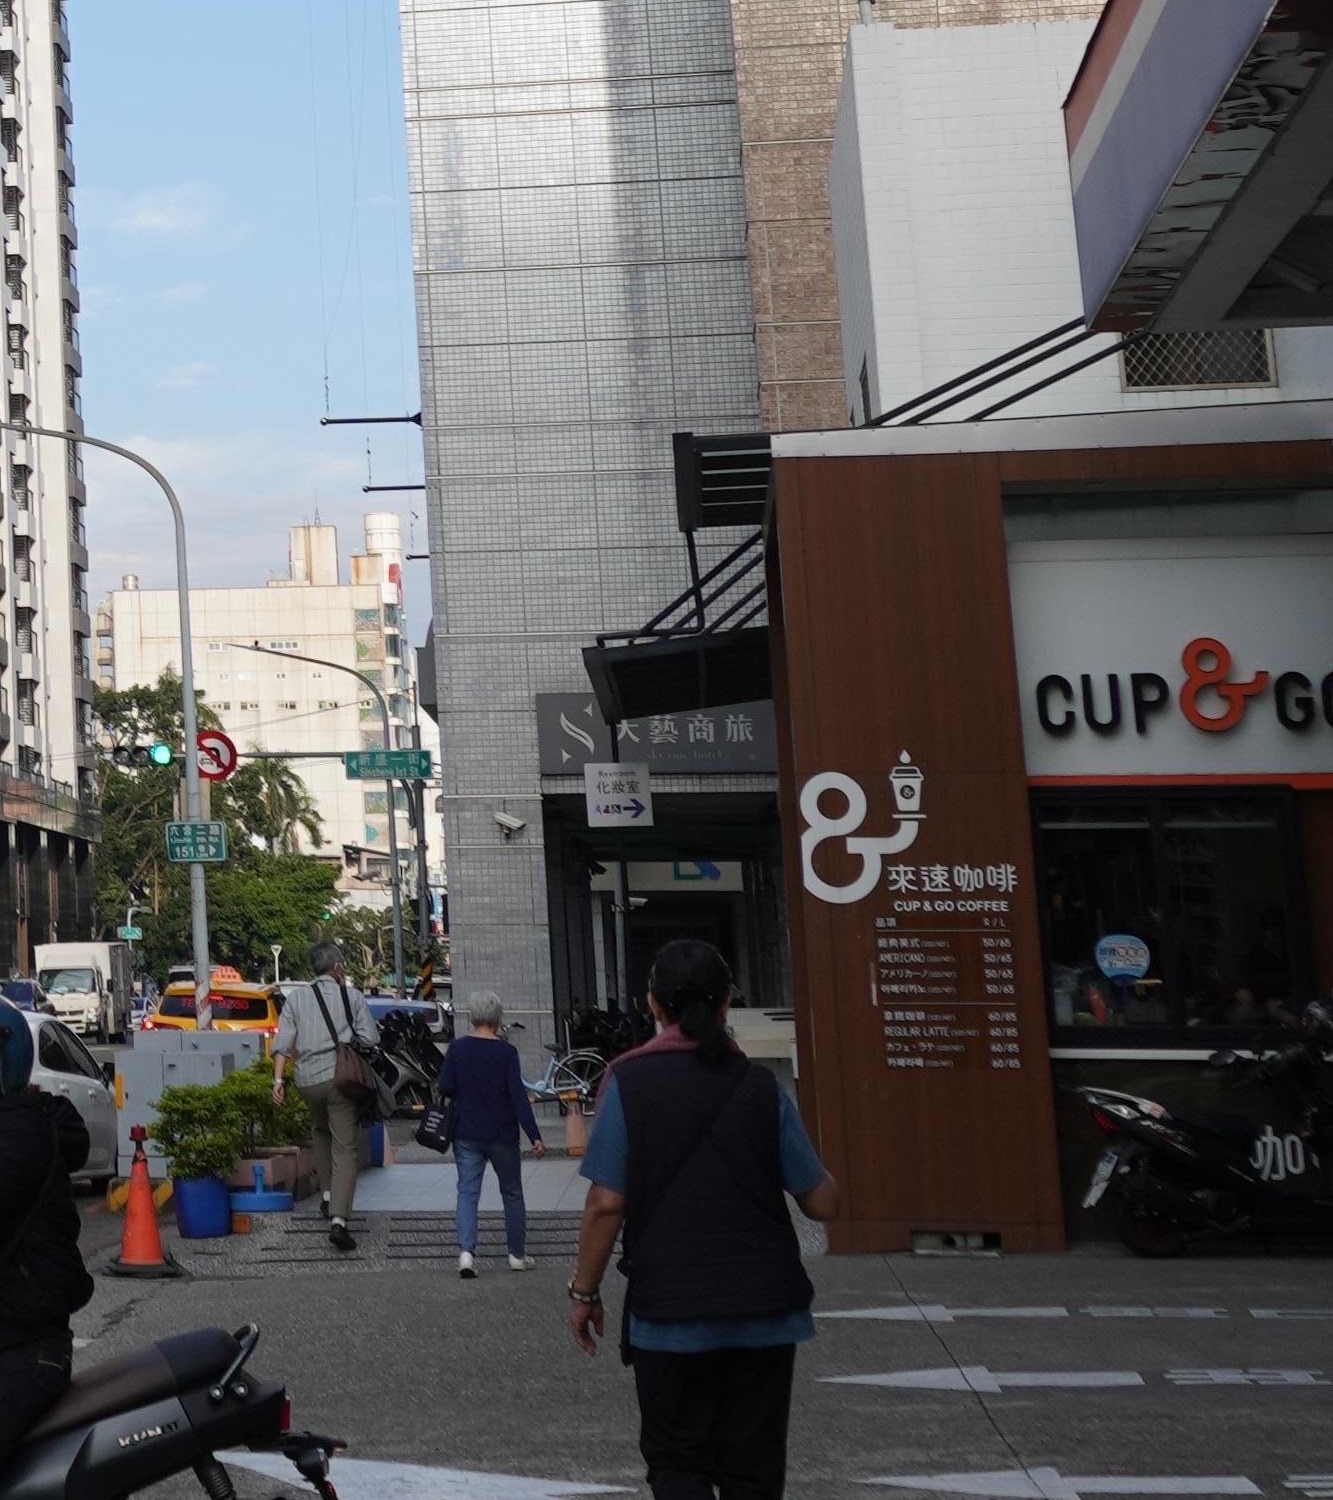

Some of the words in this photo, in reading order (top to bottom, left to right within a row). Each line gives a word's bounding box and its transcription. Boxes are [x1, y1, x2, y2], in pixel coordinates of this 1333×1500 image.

[176, 846, 194, 857] 151
[887, 863, 1018, 893] 來速咖啡
[894, 901, 921, 912] CUP
[934, 901, 955, 912] GO
[957, 901, 1009, 911] COFFEE
